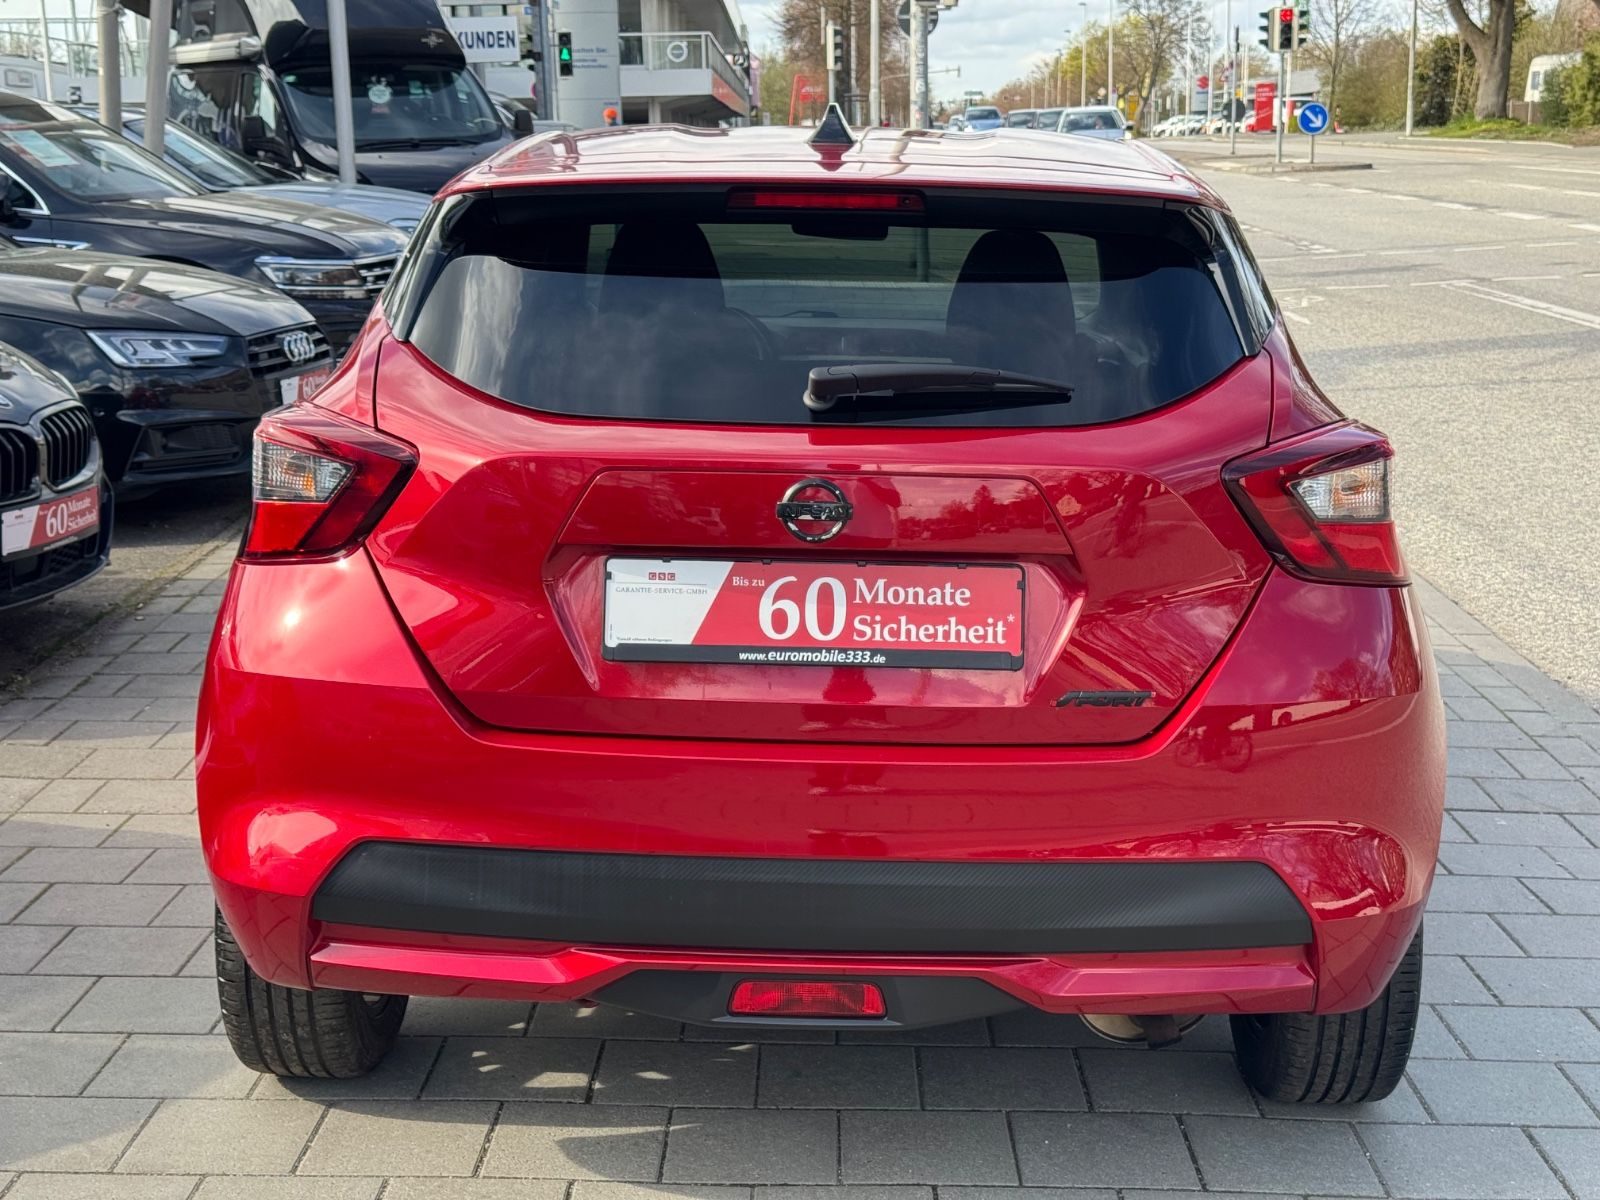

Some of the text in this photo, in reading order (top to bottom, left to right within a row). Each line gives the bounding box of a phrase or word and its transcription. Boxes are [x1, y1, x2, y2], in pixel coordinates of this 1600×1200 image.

[457, 30, 516, 49] KUNDEN
[45, 503, 68, 537] 60
[648, 571, 676, 581] GSG
[732, 576, 765, 587] Bis zu
[853, 578, 971, 607] Monate
[758, 575, 847, 641] 60
[738, 649, 886, 665] www.euromobile333.de
